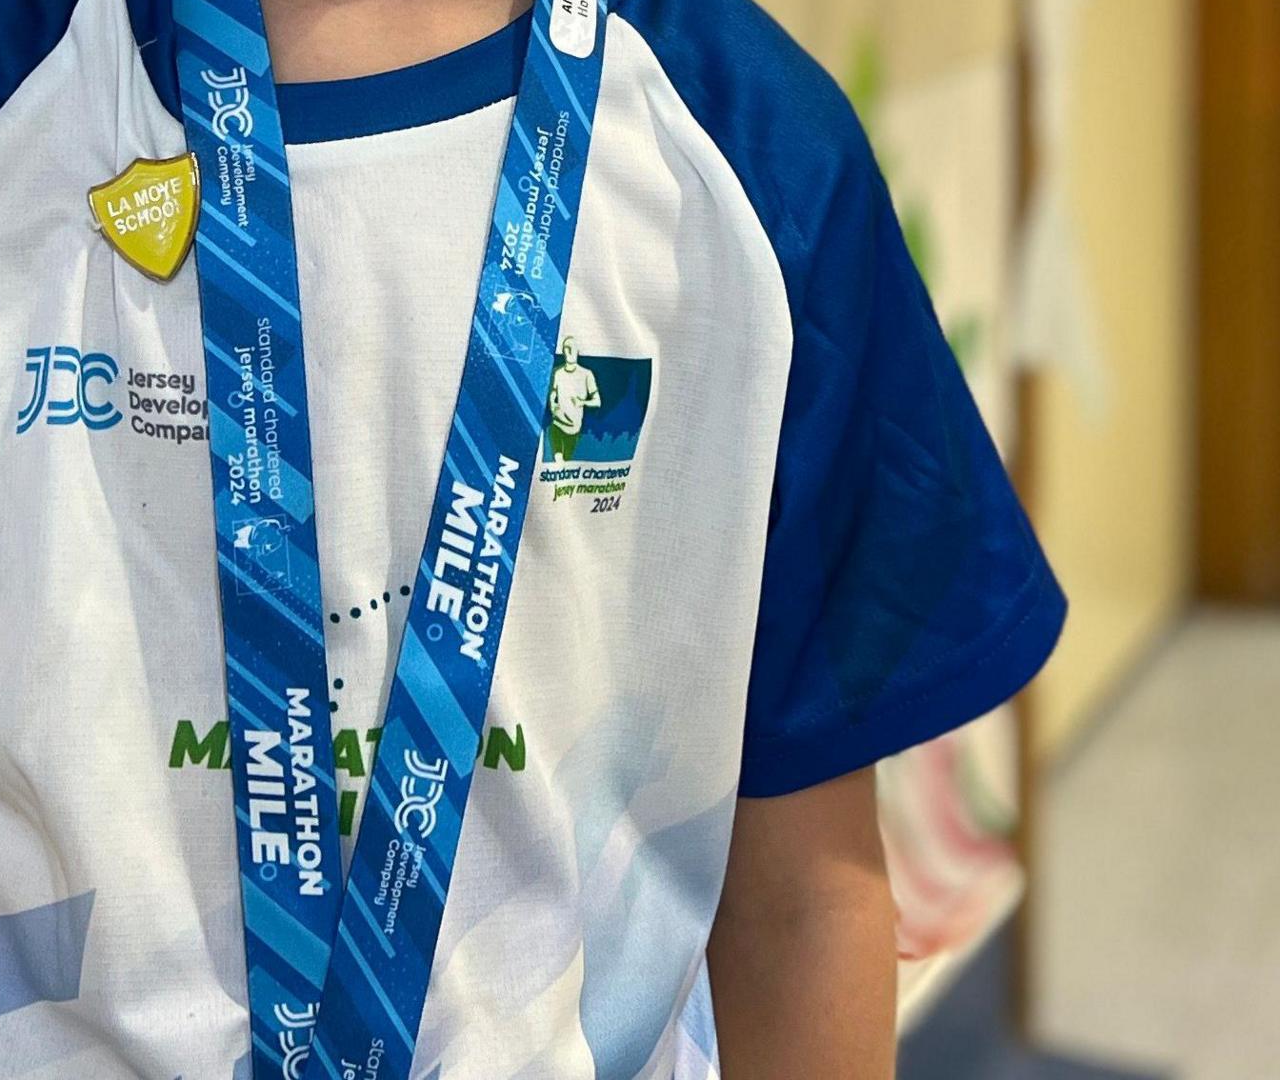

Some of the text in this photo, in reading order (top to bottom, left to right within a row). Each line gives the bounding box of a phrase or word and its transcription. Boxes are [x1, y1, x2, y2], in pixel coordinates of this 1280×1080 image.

[217, 146, 233, 206] Company
[230, 143, 250, 228] Development
[243, 143, 257, 182] Jersey
[107, 177, 182, 217] LA MOYE
[515, 126, 553, 276] jersey marathon
[531, 110, 570, 280] standard chartered
[499, 221, 520, 271] 2024
[127, 368, 195, 394] Jersey
[257, 317, 283, 501] standard chartered
[131, 415, 210, 445] Compa
[234, 346, 265, 504] jersey marathon
[228, 453, 247, 506] 2024
[576, 481, 626, 494] marathon
[590, 495, 622, 513] 2024
[426, 480, 485, 620] MILE
[460, 454, 520, 661] MARATHON
[244, 729, 290, 865] MILE
[286, 687, 324, 896] MARATHON
[374, 839, 400, 906] Company
[384, 841, 415, 935] Development
[406, 844, 426, 888] Jersey
[365, 1037, 385, 1080] stan
